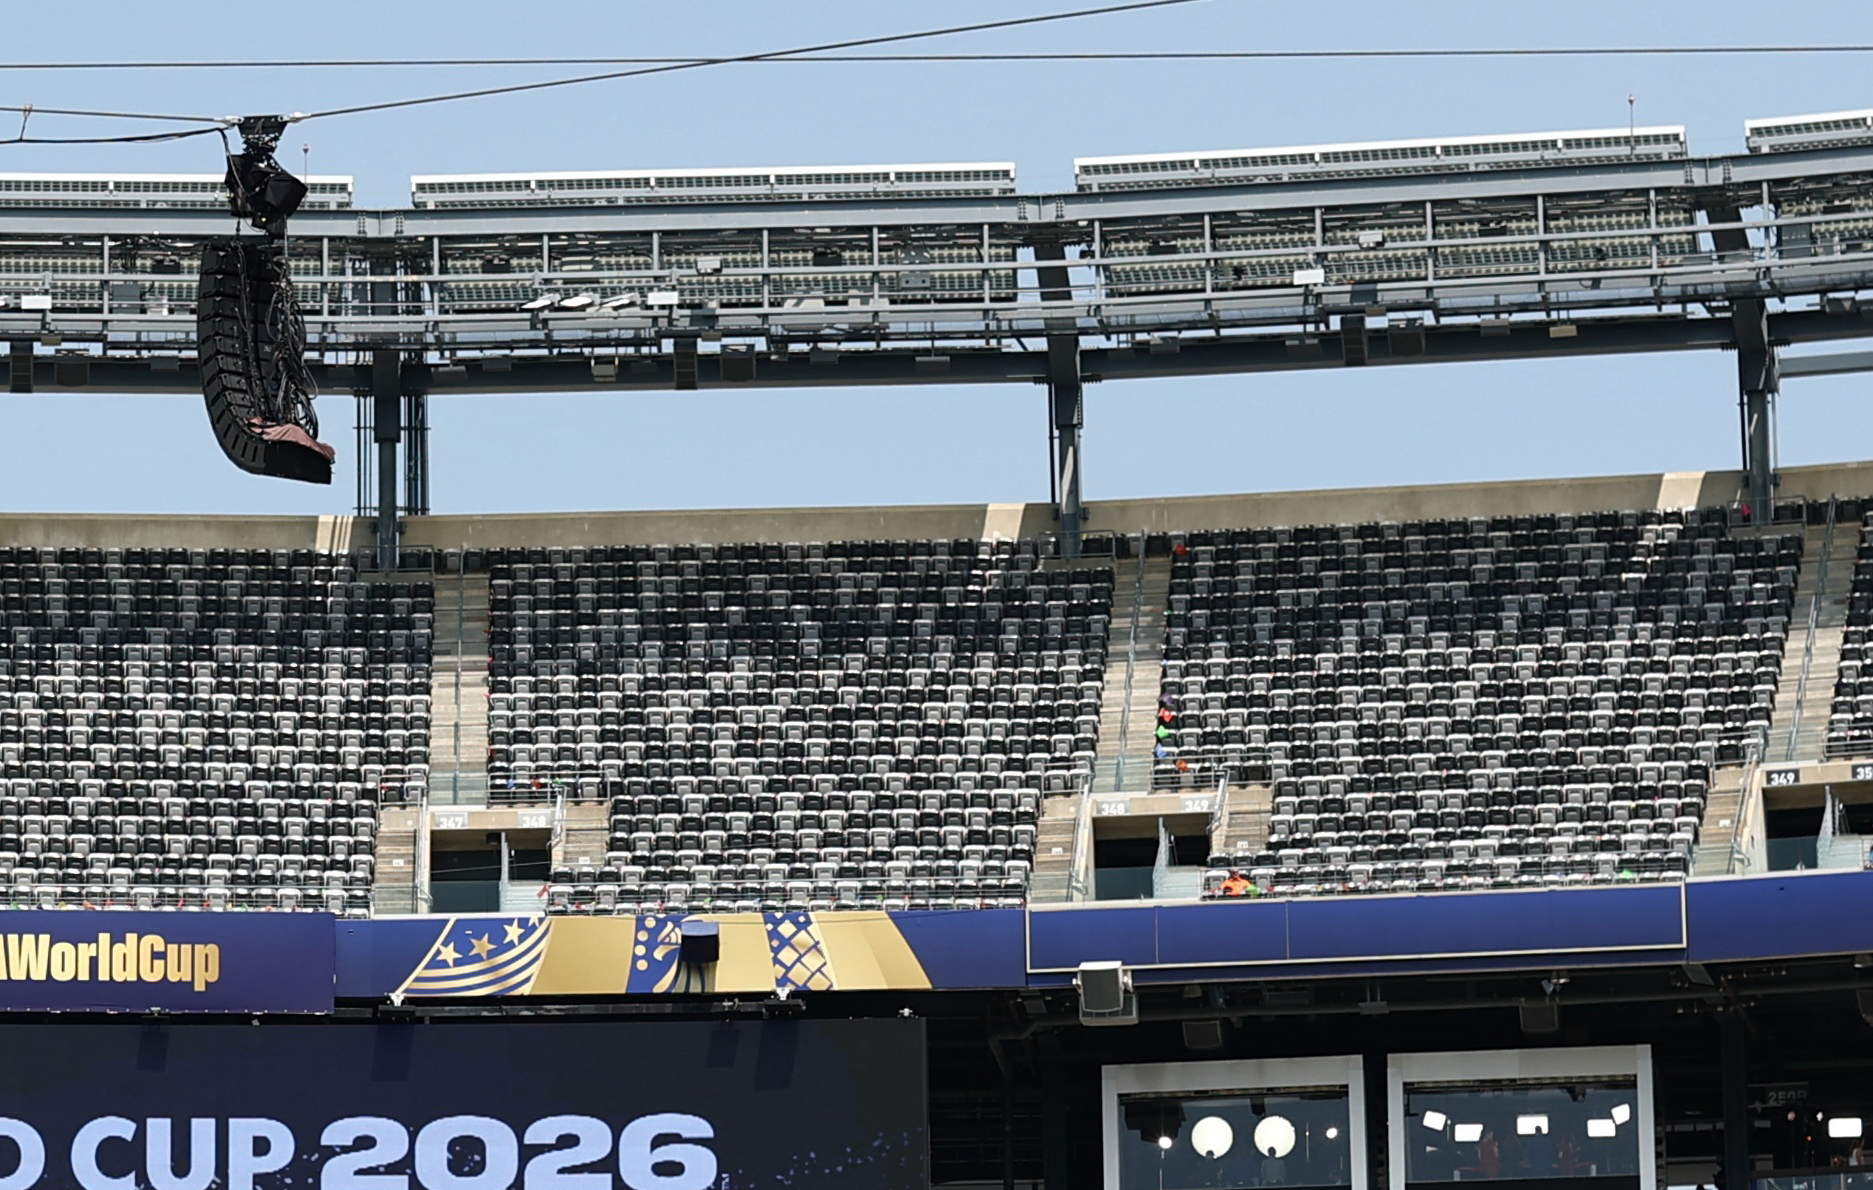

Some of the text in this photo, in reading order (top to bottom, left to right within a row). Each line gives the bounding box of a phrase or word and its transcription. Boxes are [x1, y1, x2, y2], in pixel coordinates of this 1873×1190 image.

[1771, 772, 1795, 785] 349
[1856, 766, 1873, 780] 35
[1101, 803, 1125, 815] 348
[1185, 801, 1209, 812] 349
[439, 817, 463, 829] 347
[522, 815, 546, 827] 348
